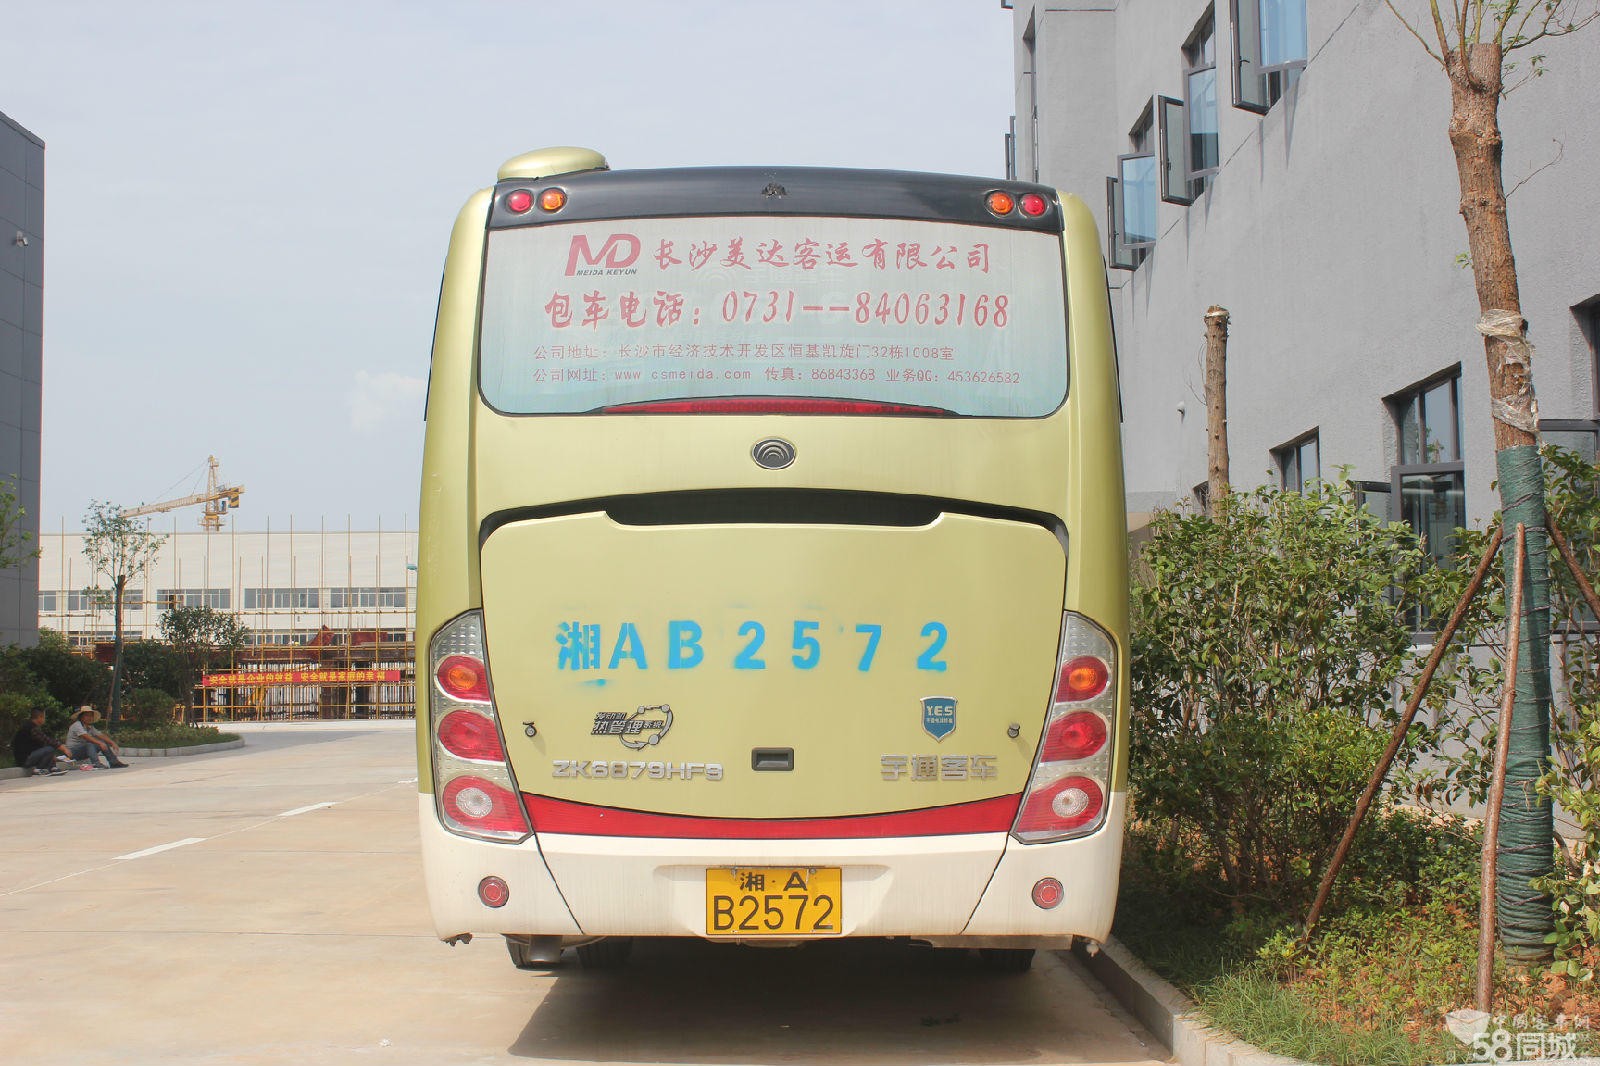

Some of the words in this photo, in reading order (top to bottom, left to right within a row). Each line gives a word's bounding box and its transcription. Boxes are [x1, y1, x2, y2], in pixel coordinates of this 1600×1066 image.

[653, 236, 990, 273] 长沙美达客运有限公司
[606, 268, 638, 276] KEYUN
[552, 760, 724, 781] ZK6879HF9
[880, 754, 998, 782] 宇通客车
[713, 894, 834, 931] B2572
